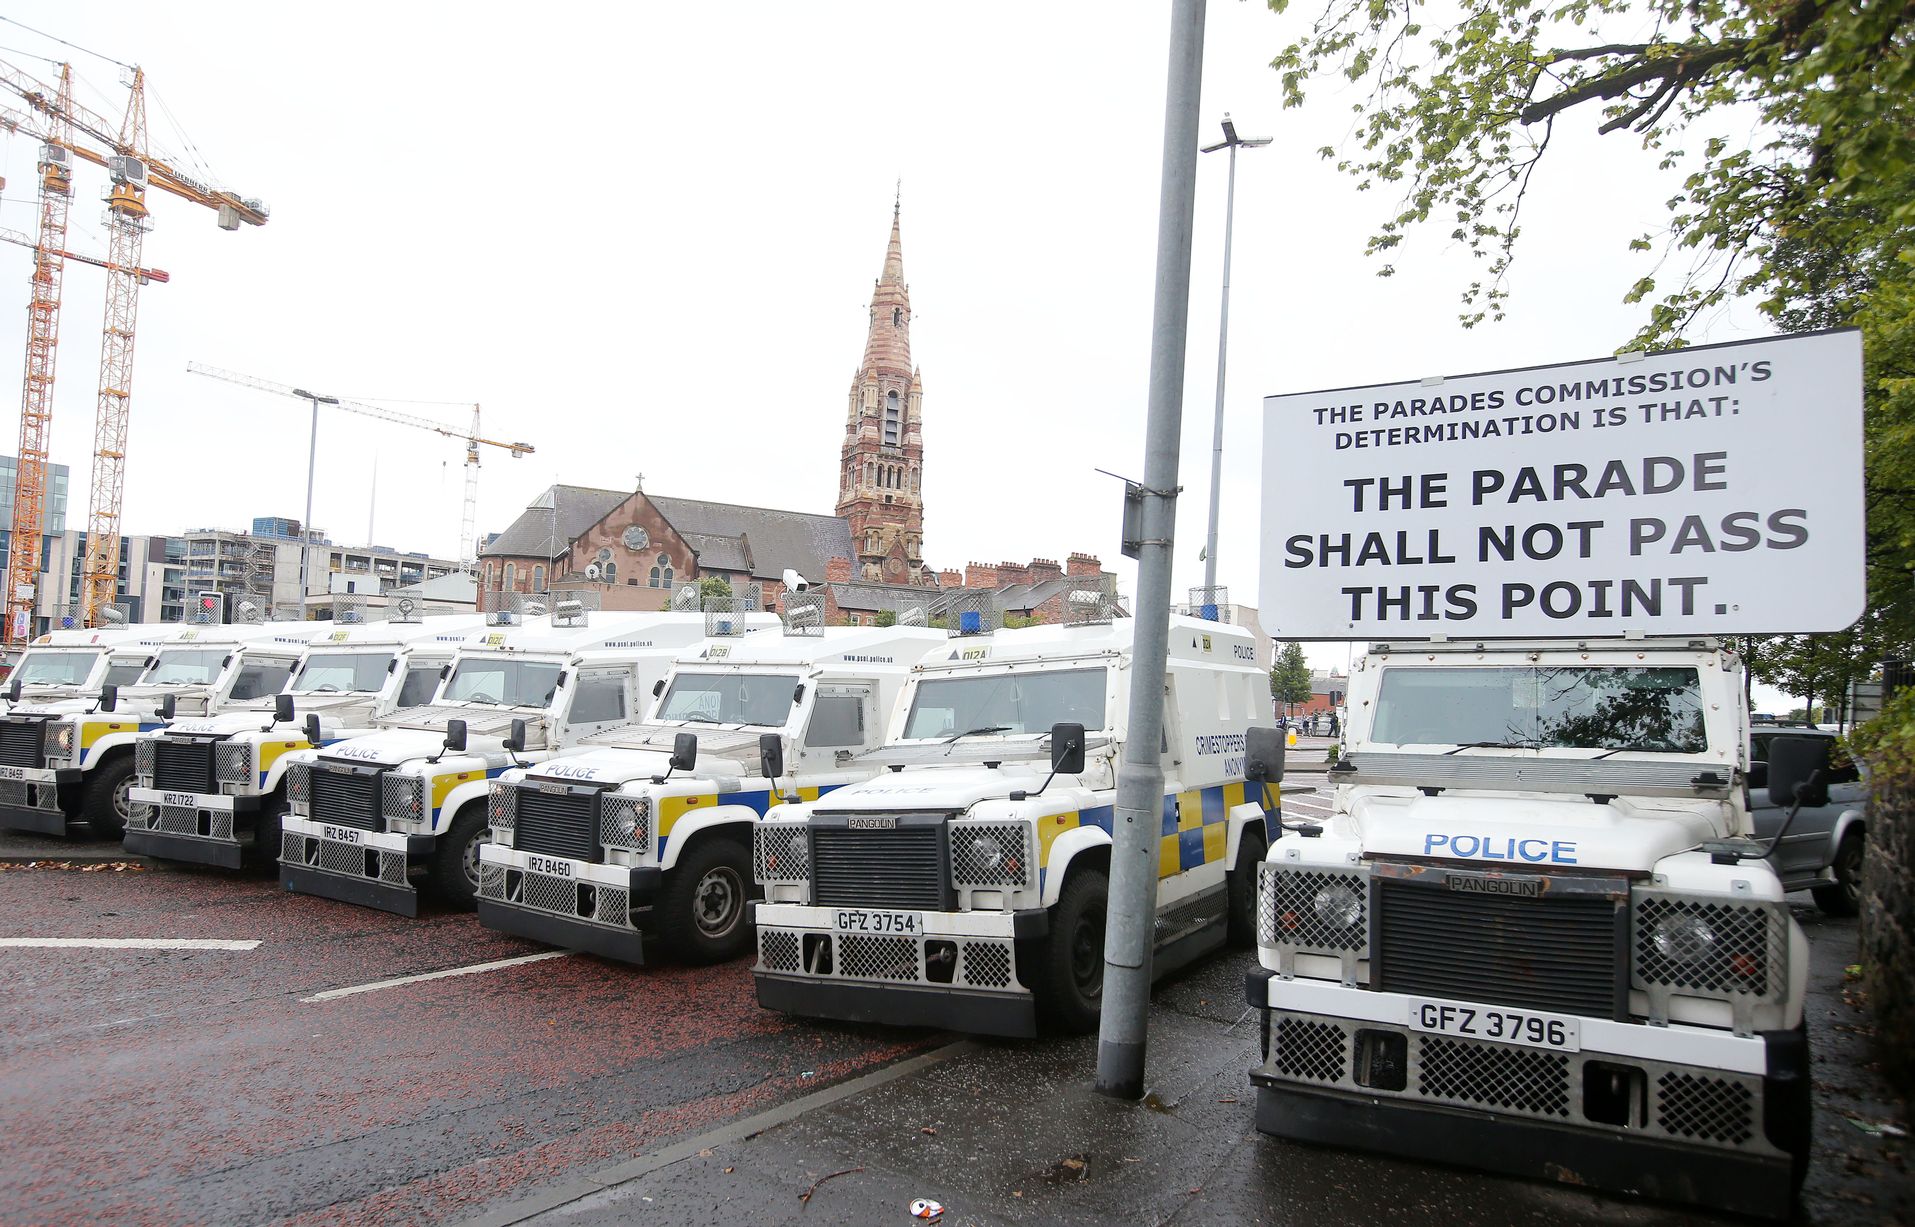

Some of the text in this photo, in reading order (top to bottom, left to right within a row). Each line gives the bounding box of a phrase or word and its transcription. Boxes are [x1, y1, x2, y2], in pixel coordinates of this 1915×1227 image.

[1313, 360, 1773, 426] THE PARADES COMMISSION'S
[1335, 397, 1741, 450] DETERMINATION IS THAT:
[1344, 451, 1728, 513] THE PARADE
[1285, 509, 1809, 568] SHALL NOT PASS
[1342, 577, 1727, 621] THIS POINT.
[1234, 644, 1254, 660] POLICE
[335, 745, 382, 760] POLICE
[1195, 734, 1245, 756] CRIMESTOPPERS
[545, 764, 601, 780] POLICE
[849, 818, 895, 829] PANGOLIN
[323, 826, 359, 844] IRZ 8457
[1423, 833, 1578, 865] POLICE
[528, 856, 571, 877] IRZ 8460
[1451, 876, 1537, 897] PANGOLIN
[838, 912, 915, 933] GFZ 3754
[1421, 1004, 1566, 1046] GFZ 3796
